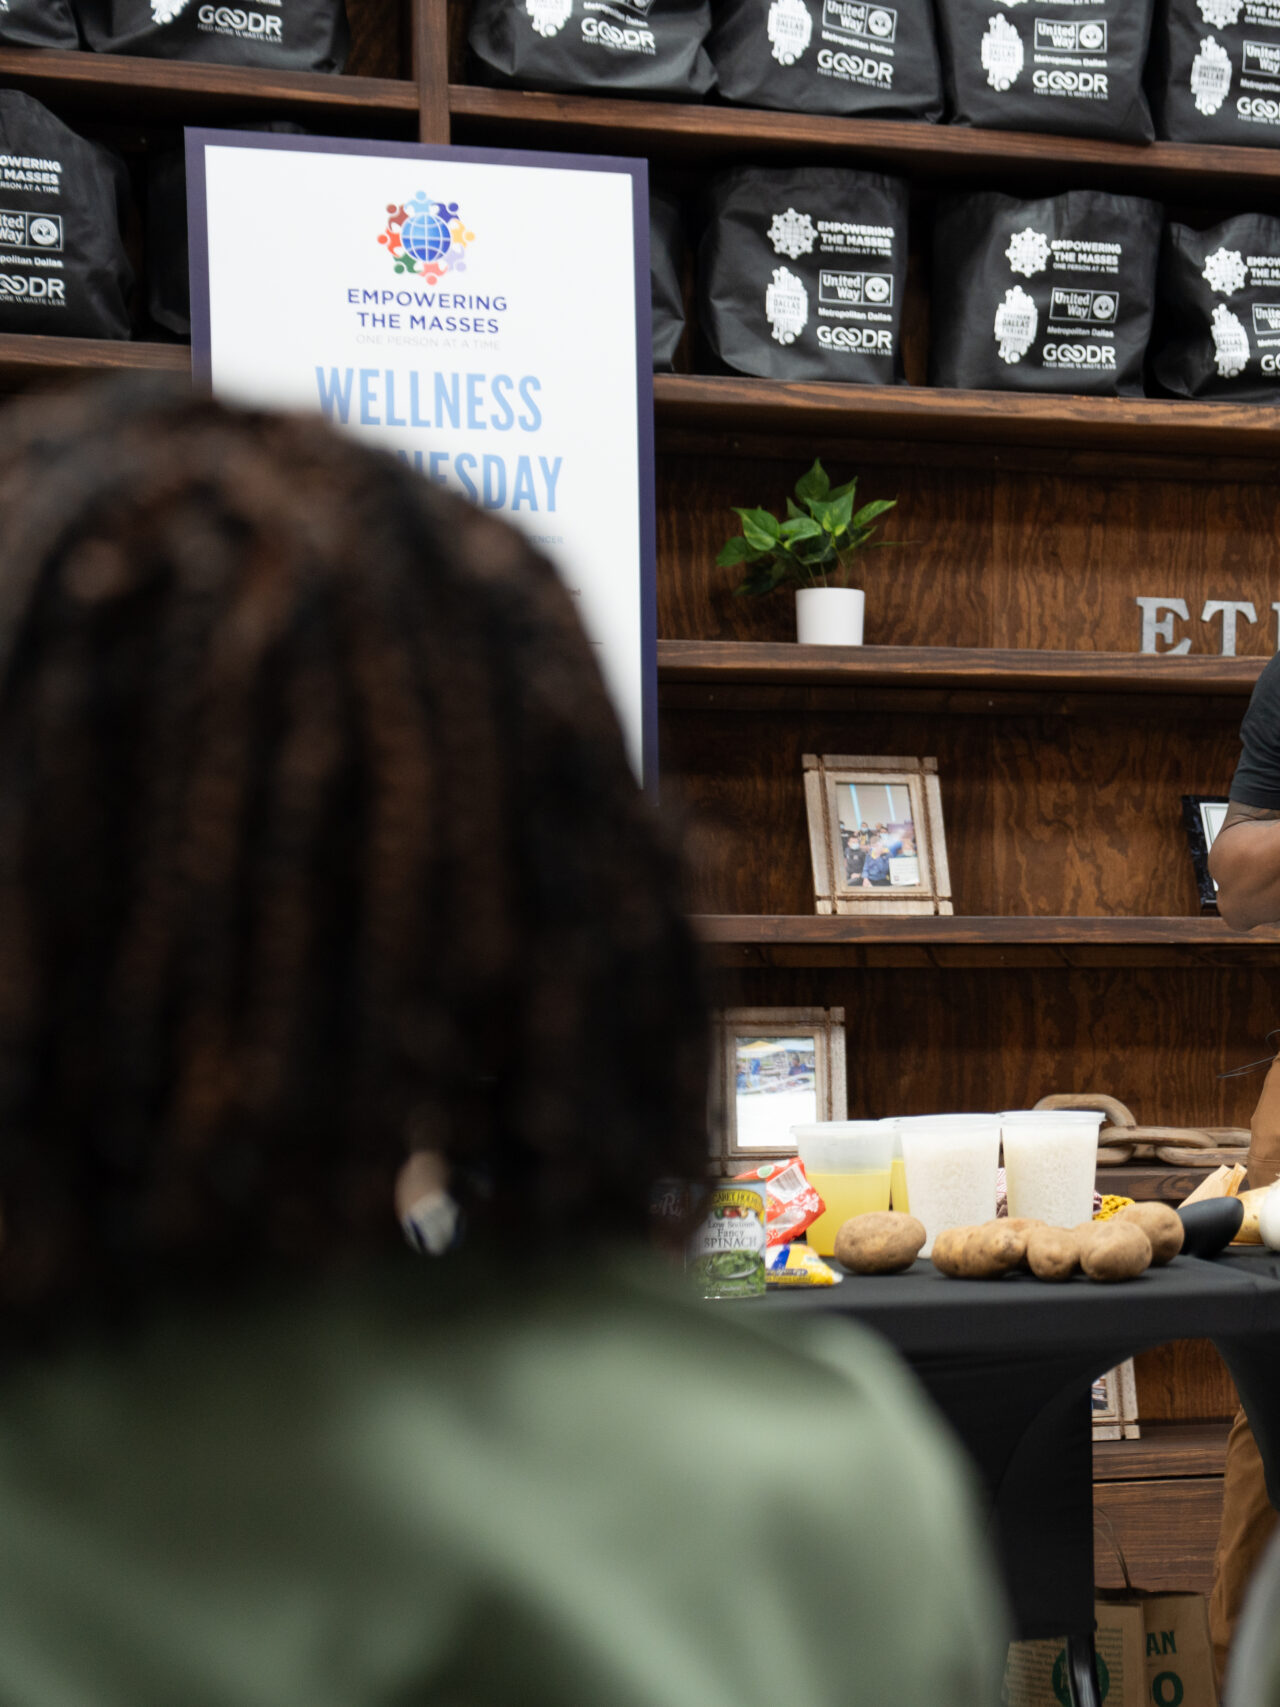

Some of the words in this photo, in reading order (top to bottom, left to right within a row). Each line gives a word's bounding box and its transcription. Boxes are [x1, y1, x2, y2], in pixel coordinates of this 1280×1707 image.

[826, 1, 865, 20] United
[1245, 4, 1267, 17] THE
[1037, 23, 1075, 38] United
[1051, 35, 1075, 50] Way
[1246, 45, 1280, 60] United
[1259, 58, 1280, 74] Way
[0, 155, 62, 173] OWERING
[4, 168, 59, 185] MASSES
[0, 214, 24, 229] ited
[817, 221, 895, 238] EMPOWERING
[820, 233, 844, 245] THE
[846, 235, 892, 248] MASSES
[1050, 240, 1122, 255] EMPOWERING
[0, 254, 32, 266] politan
[34, 257, 63, 268] Dallas
[1052, 262, 1066, 270] ONE
[1053, 251, 1077, 263] THE
[1077, 252, 1119, 266] MASSES
[1250, 268, 1269, 278] THE
[0, 273, 65, 298] OODR
[822, 274, 861, 288] United
[347, 288, 508, 312] EMPOWERING
[837, 286, 861, 301] Way
[1054, 292, 1090, 306] United
[773, 300, 801, 310] DALLAS
[1067, 304, 1089, 319] Way
[818, 307, 867, 320] Metropolitan
[867, 311, 892, 322] Dallas
[356, 312, 401, 329] THE
[409, 314, 500, 334] MASSES
[1046, 326, 1090, 337] Metropolitan
[1091, 328, 1114, 338] Dallas
[355, 334, 383, 345] ONE
[387, 334, 439, 348] PERSON
[442, 338, 457, 348] AT
[460, 339, 470, 349] A
[473, 339, 501, 351] TIME
[315, 366, 542, 432] WELLNESS
[717, 1228, 745, 1239] Fancy
[703, 1237, 758, 1249] SPINACH
